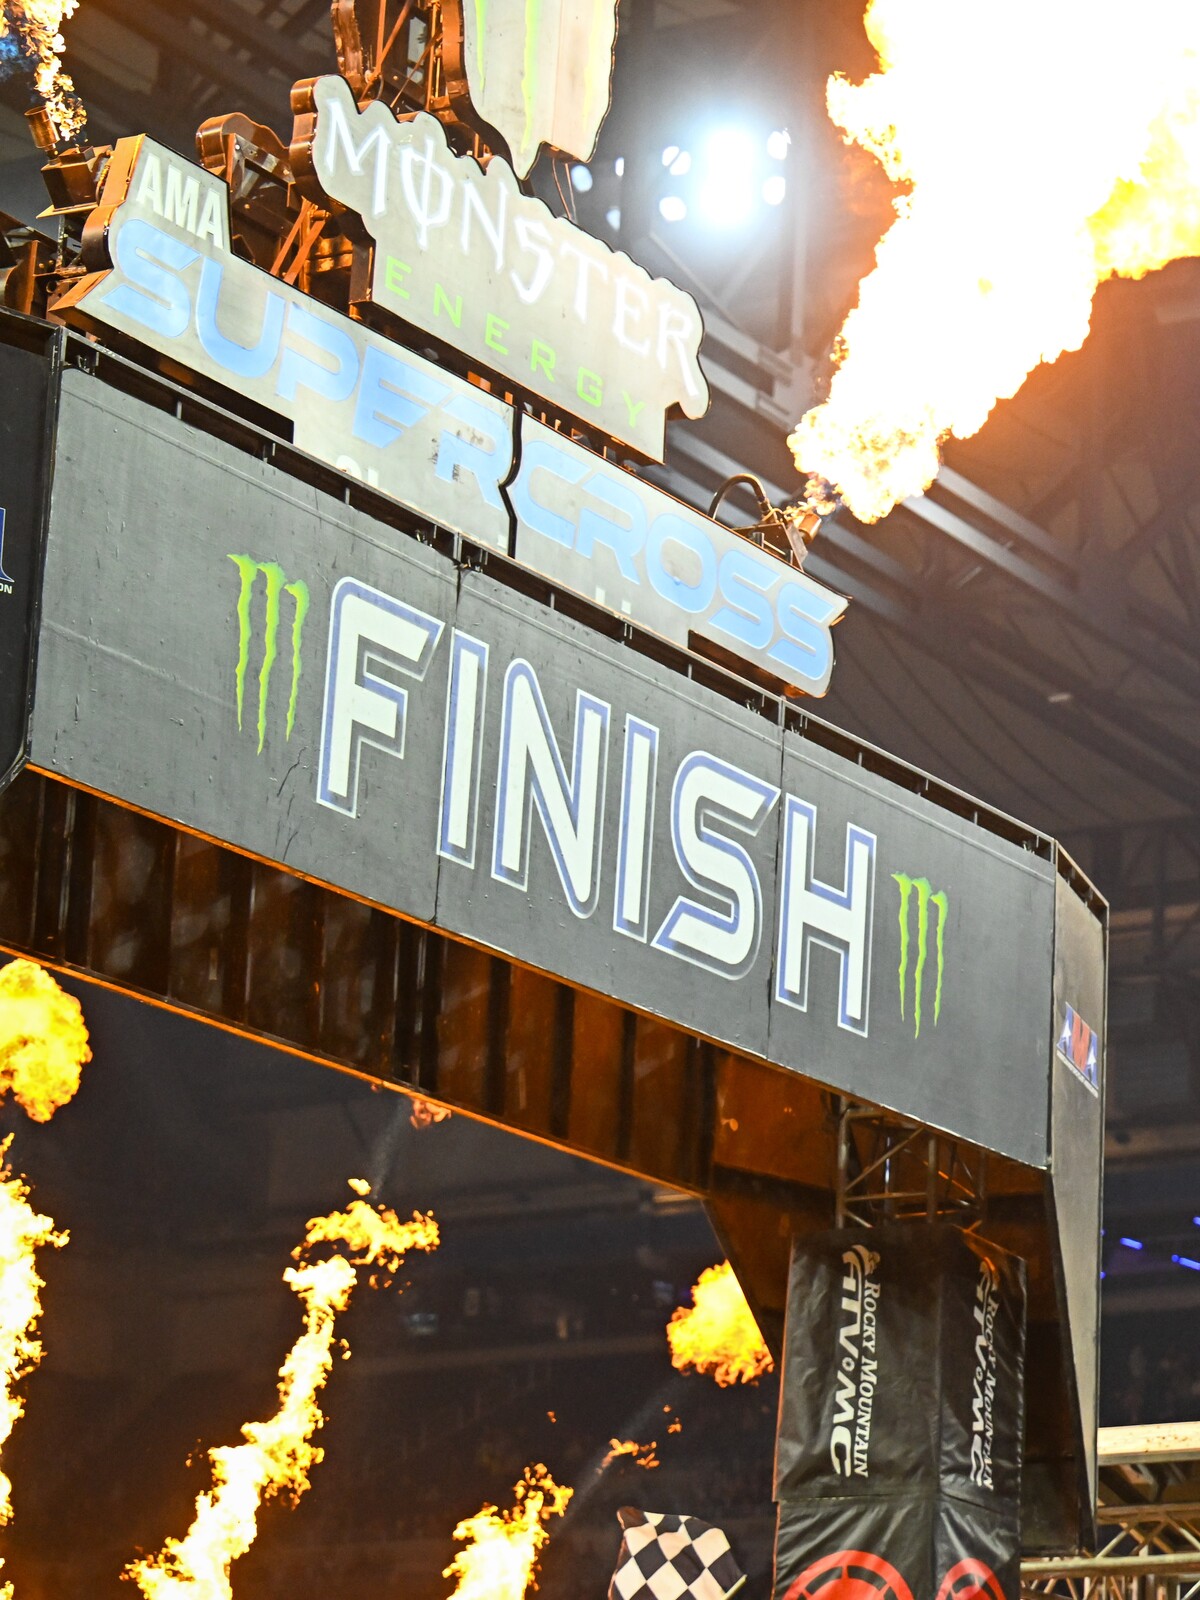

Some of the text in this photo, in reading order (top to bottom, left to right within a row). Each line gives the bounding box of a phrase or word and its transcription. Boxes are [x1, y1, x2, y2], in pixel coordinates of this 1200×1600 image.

[138, 156, 226, 250] AMA
[324, 98, 702, 397] MONSTER
[386, 257, 649, 430] ENERGY
[99, 218, 834, 682] SUPERCROSS
[316, 576, 877, 1038] FINISH
[854, 1279, 881, 1478] ROCKY MOUNTAIN
[980, 1297, 999, 1490] ROCKY MOUNTAIN
